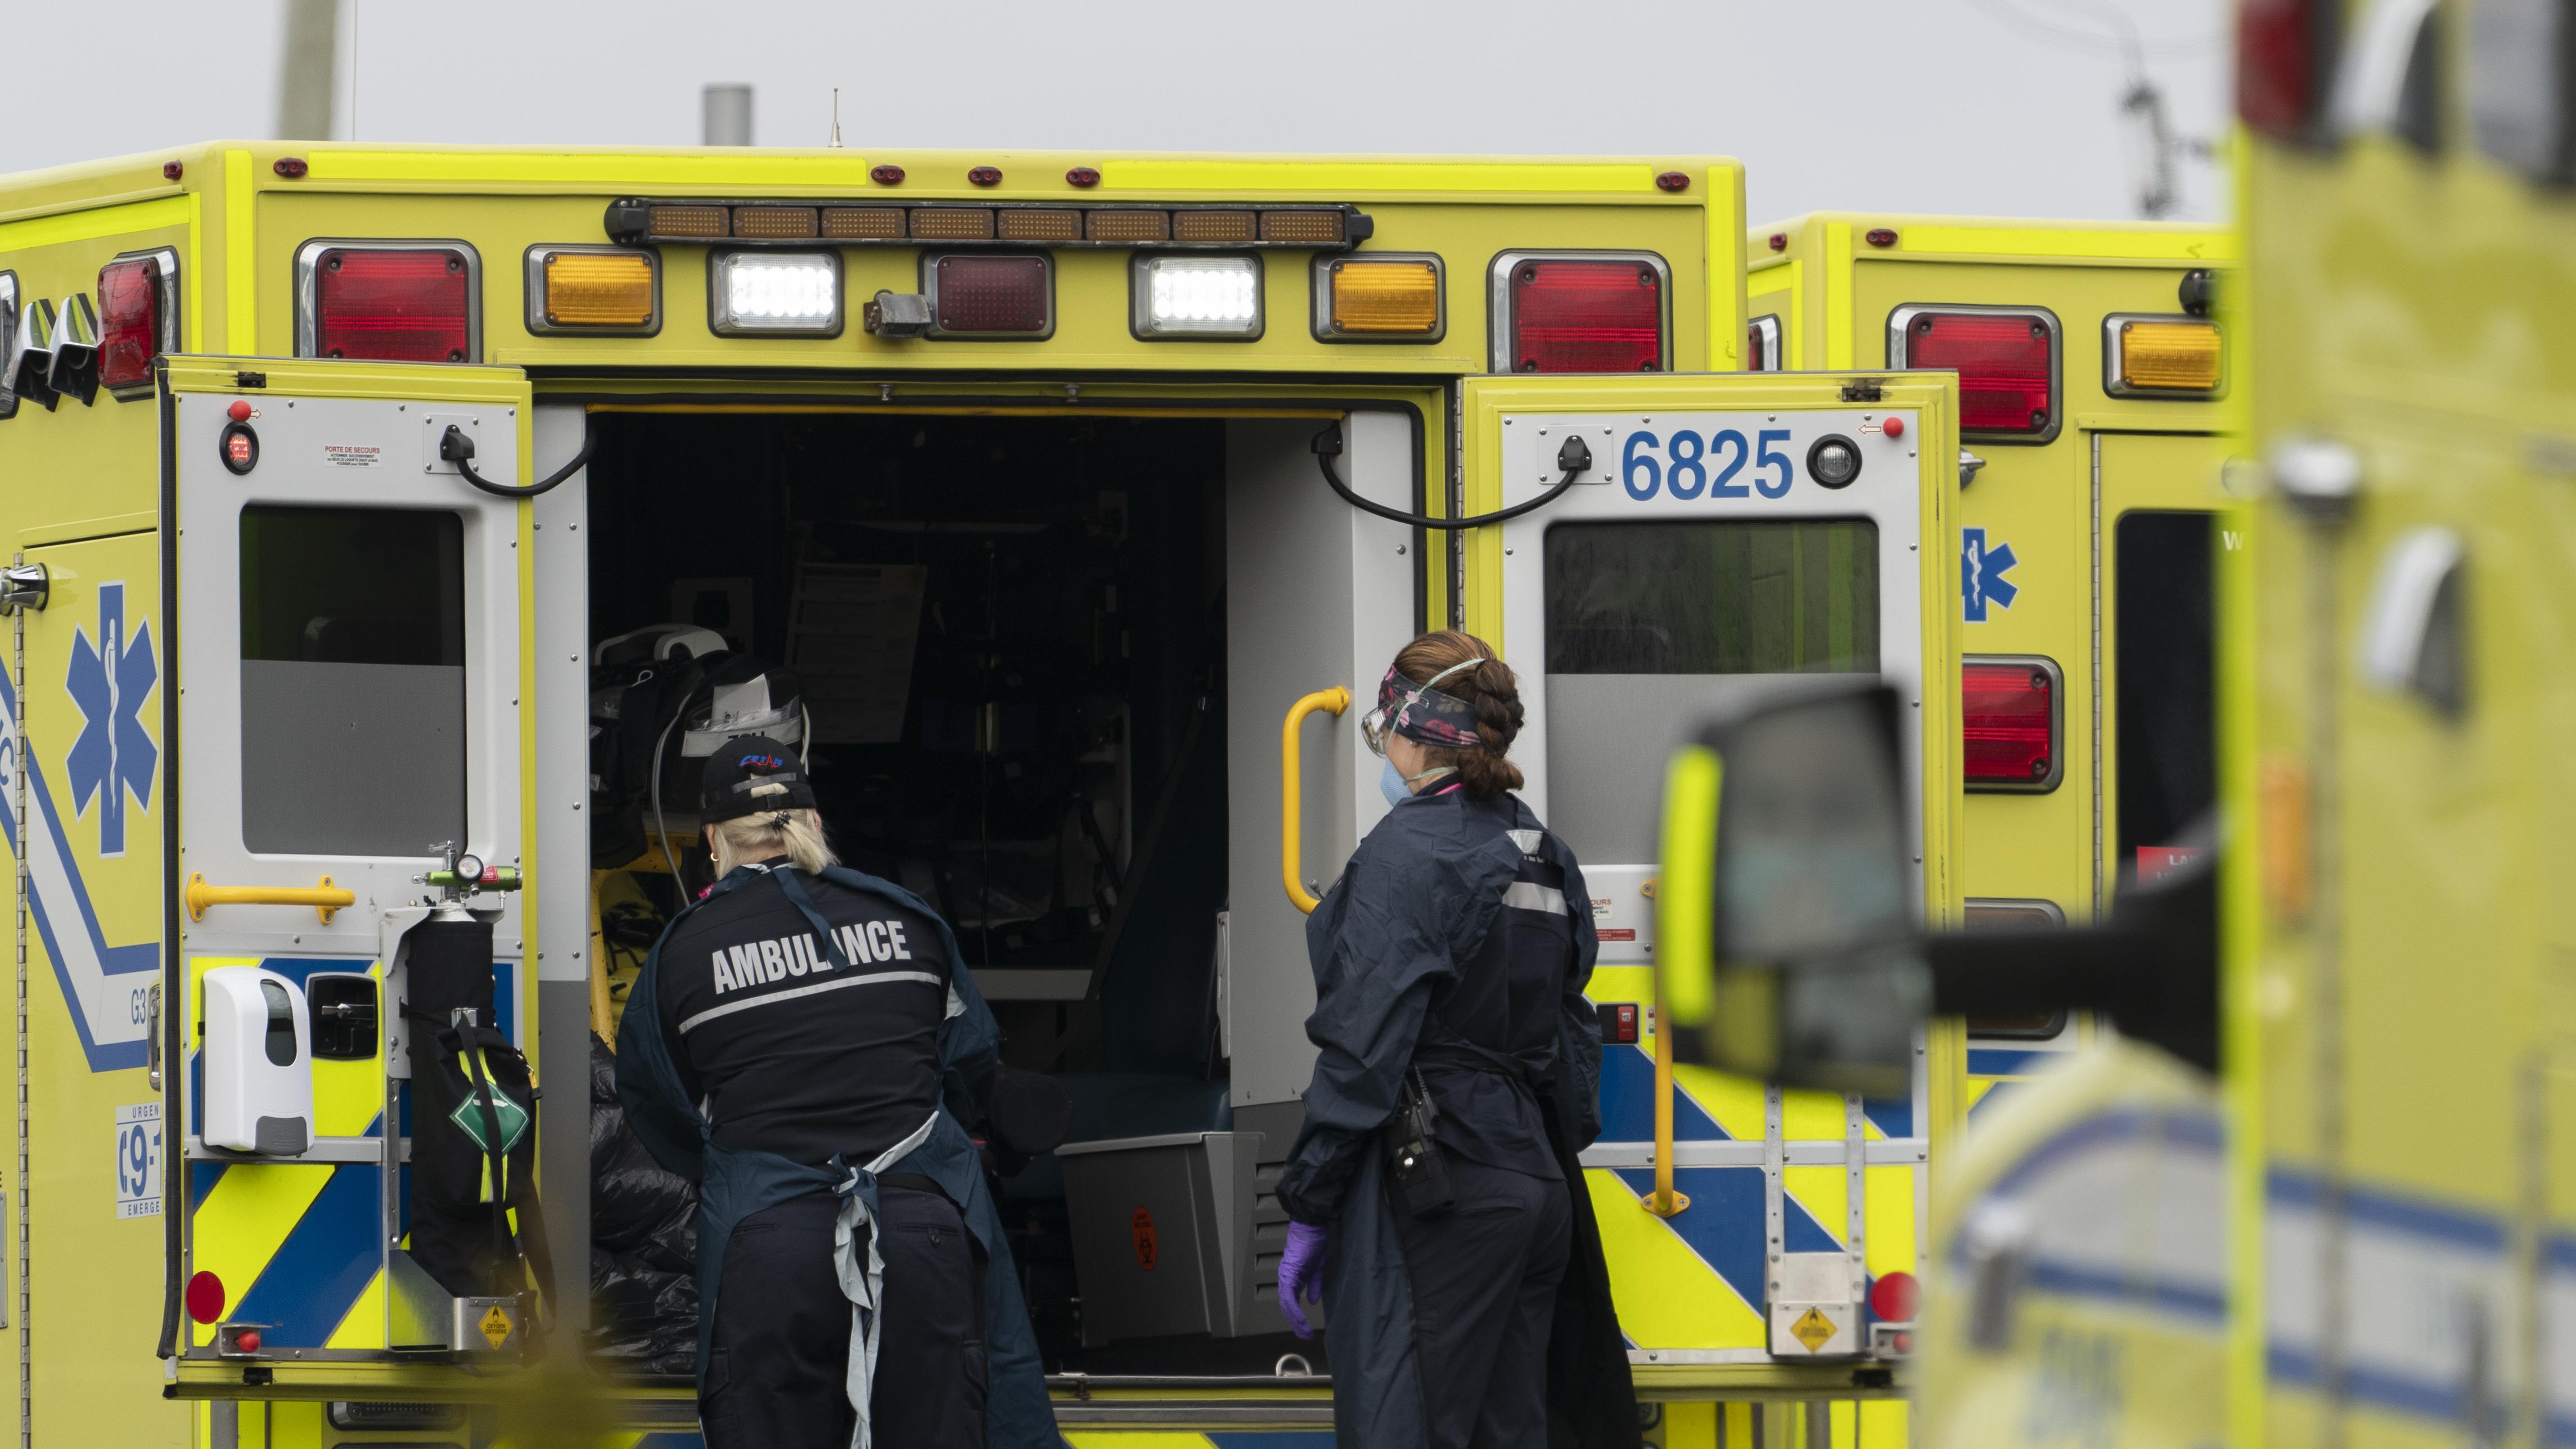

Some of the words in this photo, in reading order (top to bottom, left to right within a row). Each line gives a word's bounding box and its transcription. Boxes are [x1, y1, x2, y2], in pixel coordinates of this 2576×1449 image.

[1623, 429, 1793, 501] 6825
[131, 988, 146, 1025] G3
[132, 1104, 159, 1118] URGEN
[128, 1201, 160, 1216] EMERGE
